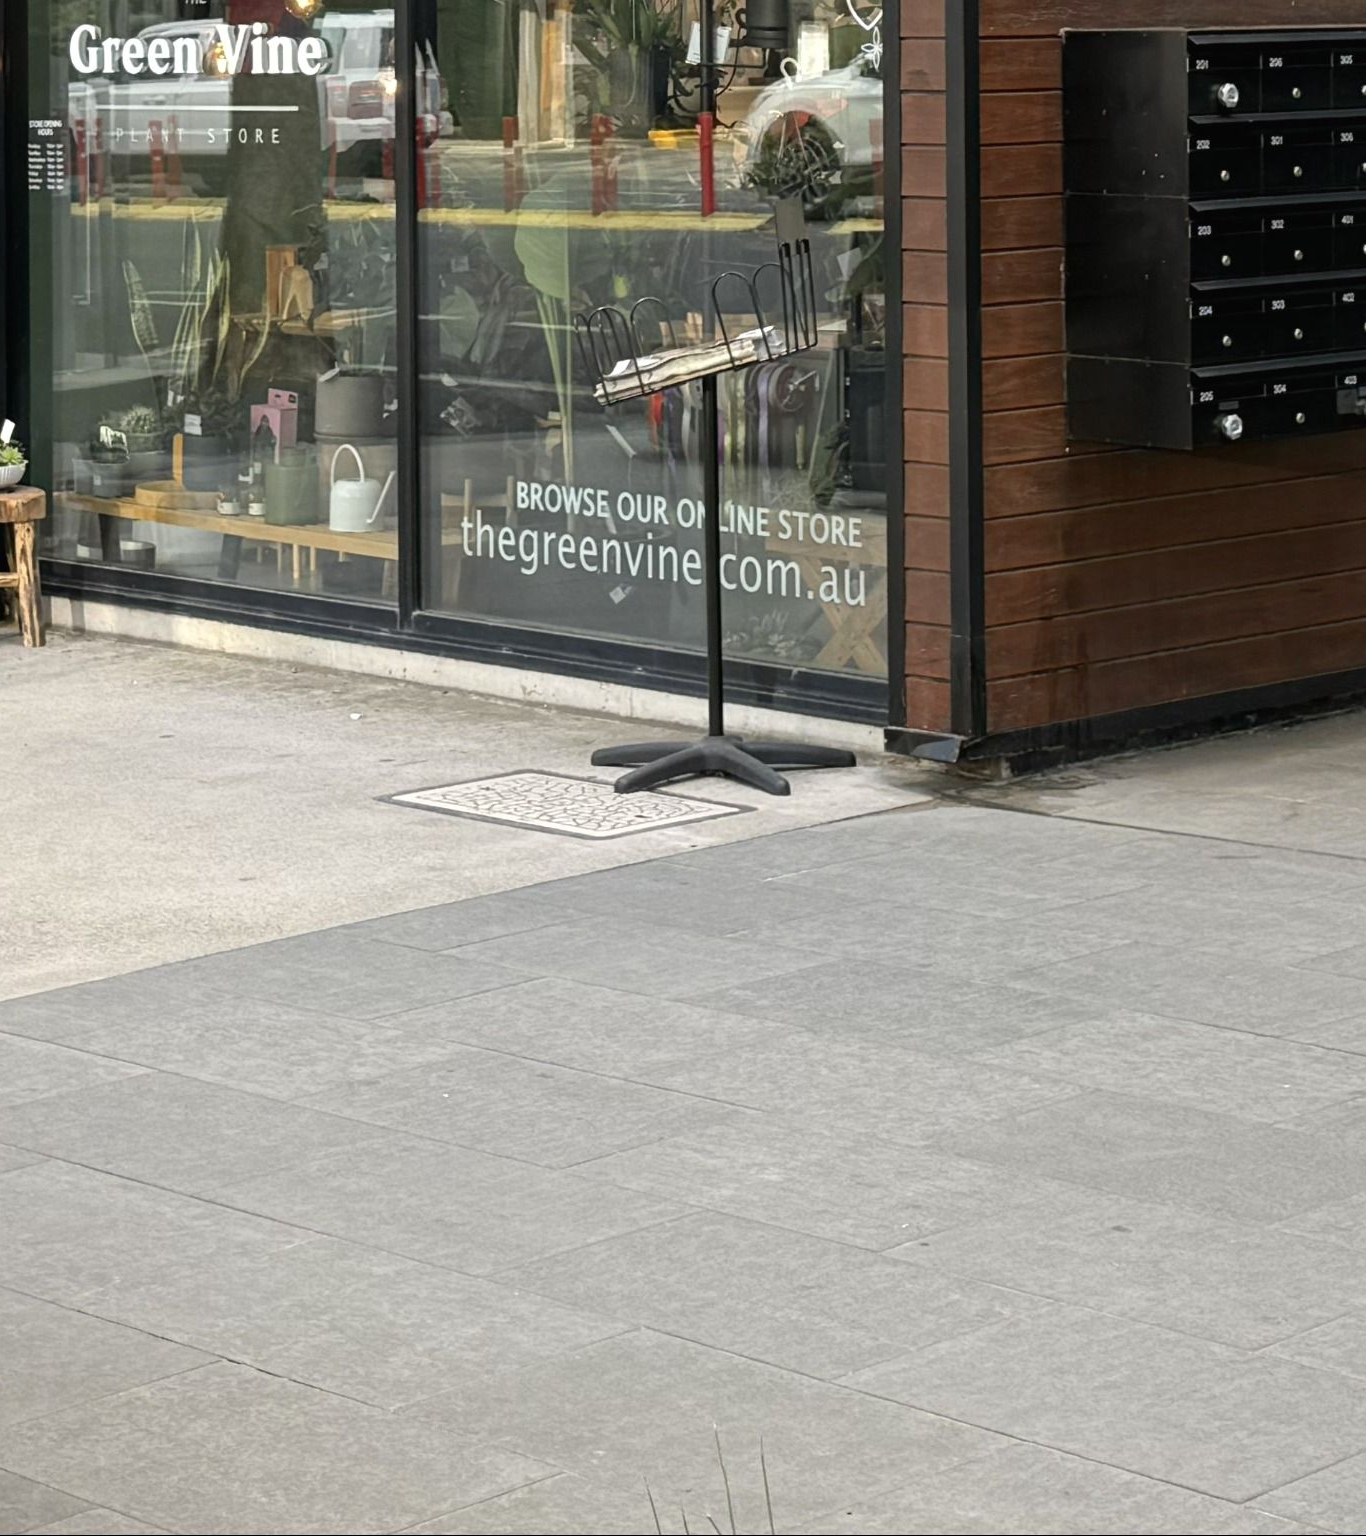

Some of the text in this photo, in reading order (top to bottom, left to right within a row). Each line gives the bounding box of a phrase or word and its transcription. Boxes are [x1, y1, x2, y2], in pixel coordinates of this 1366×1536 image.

[69, 21, 327, 76] Green Vine
[1195, 59, 1209, 70] 201
[115, 127, 282, 145] PLANT STORE
[1197, 225, 1212, 236] 203
[1198, 305, 1213, 316] 204
[1199, 391, 1214, 402] 205
[516, 480, 864, 548] BROWSE OUR ONINE STORE
[460, 508, 867, 607] thegreenvinecom.au
